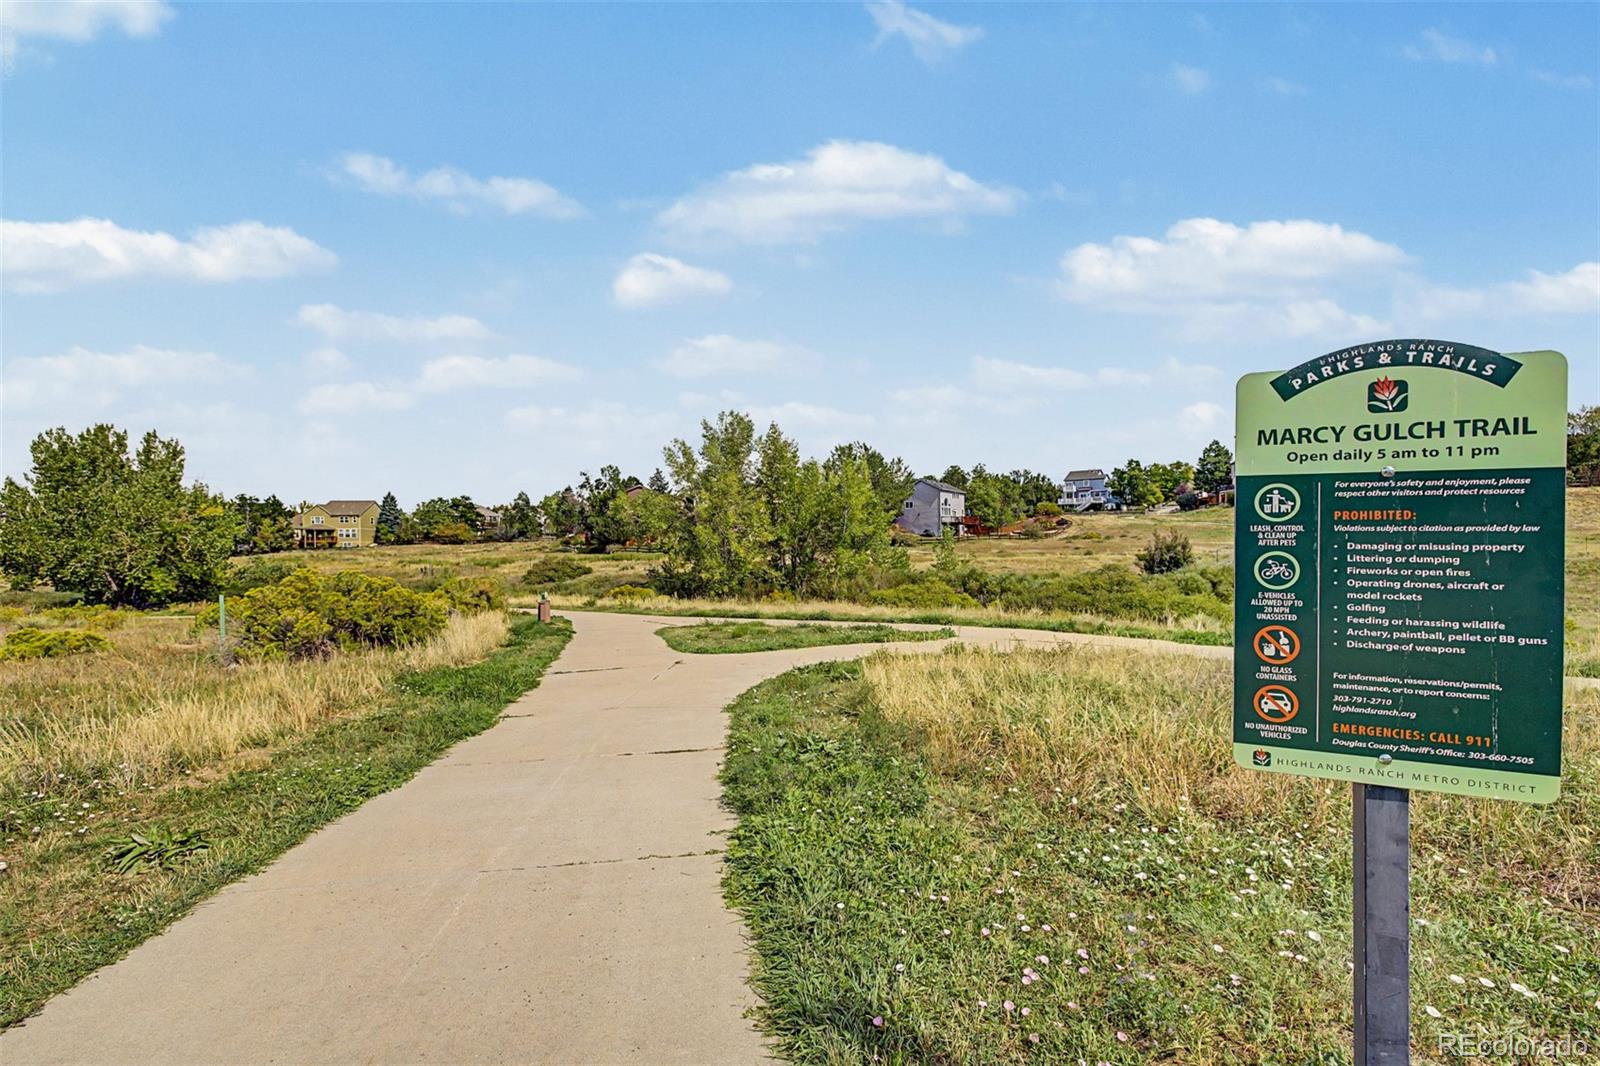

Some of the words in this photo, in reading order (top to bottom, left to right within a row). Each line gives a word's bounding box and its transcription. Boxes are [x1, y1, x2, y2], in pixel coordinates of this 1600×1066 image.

[1328, 343, 1402, 361] HIGHLANDS
[1410, 343, 1454, 353] RANCH
[1292, 356, 1364, 390] PARKS
[1379, 353, 1391, 364] &
[1407, 352, 1497, 376] TRAILS
[1257, 426, 1346, 445] MARCY
[1354, 421, 1445, 441] GULCH
[1454, 417, 1537, 437] TRAIL
[1287, 451, 1327, 463] Open
[1333, 448, 1372, 462] daily
[1377, 449, 1386, 459] 5
[1392, 450, 1416, 458] am
[1422, 448, 1439, 457] to
[1446, 446, 1464, 456] 11
[1472, 445, 1499, 458] pm
[1396, 479, 1424, 488] safety
[1445, 478, 1497, 486] enjoyment,
[1499, 477, 1530, 486] please
[1334, 510, 1416, 520] PROHIBITED:
[1376, 525, 1407, 533] subject
[1465, 525, 1508, 533] provided
[1510, 525, 1521, 534] by
[1347, 543, 1401, 552] Damaging
[1419, 543, 1469, 552] misusing
[1472, 543, 1524, 553] property
[1347, 555, 1392, 564] Littering
[1409, 556, 1460, 565] dumping
[1415, 569, 1443, 577] open
[1446, 568, 1470, 576] fires
[1347, 579, 1400, 590] Operating
[1403, 581, 1444, 590] drones,
[1447, 581, 1489, 590] aircraft
[1382, 593, 1422, 601] rockets
[1347, 604, 1385, 613] Golfing
[1347, 616, 1389, 626] Feeding
[1406, 618, 1459, 629] harassing
[1462, 620, 1505, 630] wildlife
[1347, 628, 1390, 639] Archery,
[1393, 630, 1445, 641] paintball,
[1448, 633, 1481, 643] pellet
[1518, 637, 1548, 646] guns
[1347, 641, 1400, 651] Discharge
[1416, 645, 1466, 655] weapons
[1256, 673, 1297, 682] CONTAINERS
[1348, 673, 1402, 684] information,
[1404, 678, 1502, 691] reservations/permits,
[1333, 682, 1390, 693] maintenance,
[1415, 688, 1444, 697] report
[1445, 690, 1490, 700] concerns:
[1333, 694, 1392, 705] 303-791-2710
[1332, 704, 1416, 719] highlandsranch.org
[1256, 724, 1307, 734] UNAUTHORIZED
[1332, 722, 1425, 740] EMERGENCIES:
[1430, 732, 1461, 744] CALL
[1466, 735, 1491, 747] 911
[1260, 731, 1291, 740] VEHICLES
[1332, 738, 1366, 748] Douglas
[1368, 741, 1398, 752] County
[1436, 748, 1465, 758] Office:
[1468, 751, 1534, 765] 303-660-7505
[1277, 758, 1351, 772] HIGHLANDS
[1359, 767, 1404, 779] RANCH
[1412, 774, 1460, 786] METRO
[1468, 780, 1537, 794] DISTRICT
